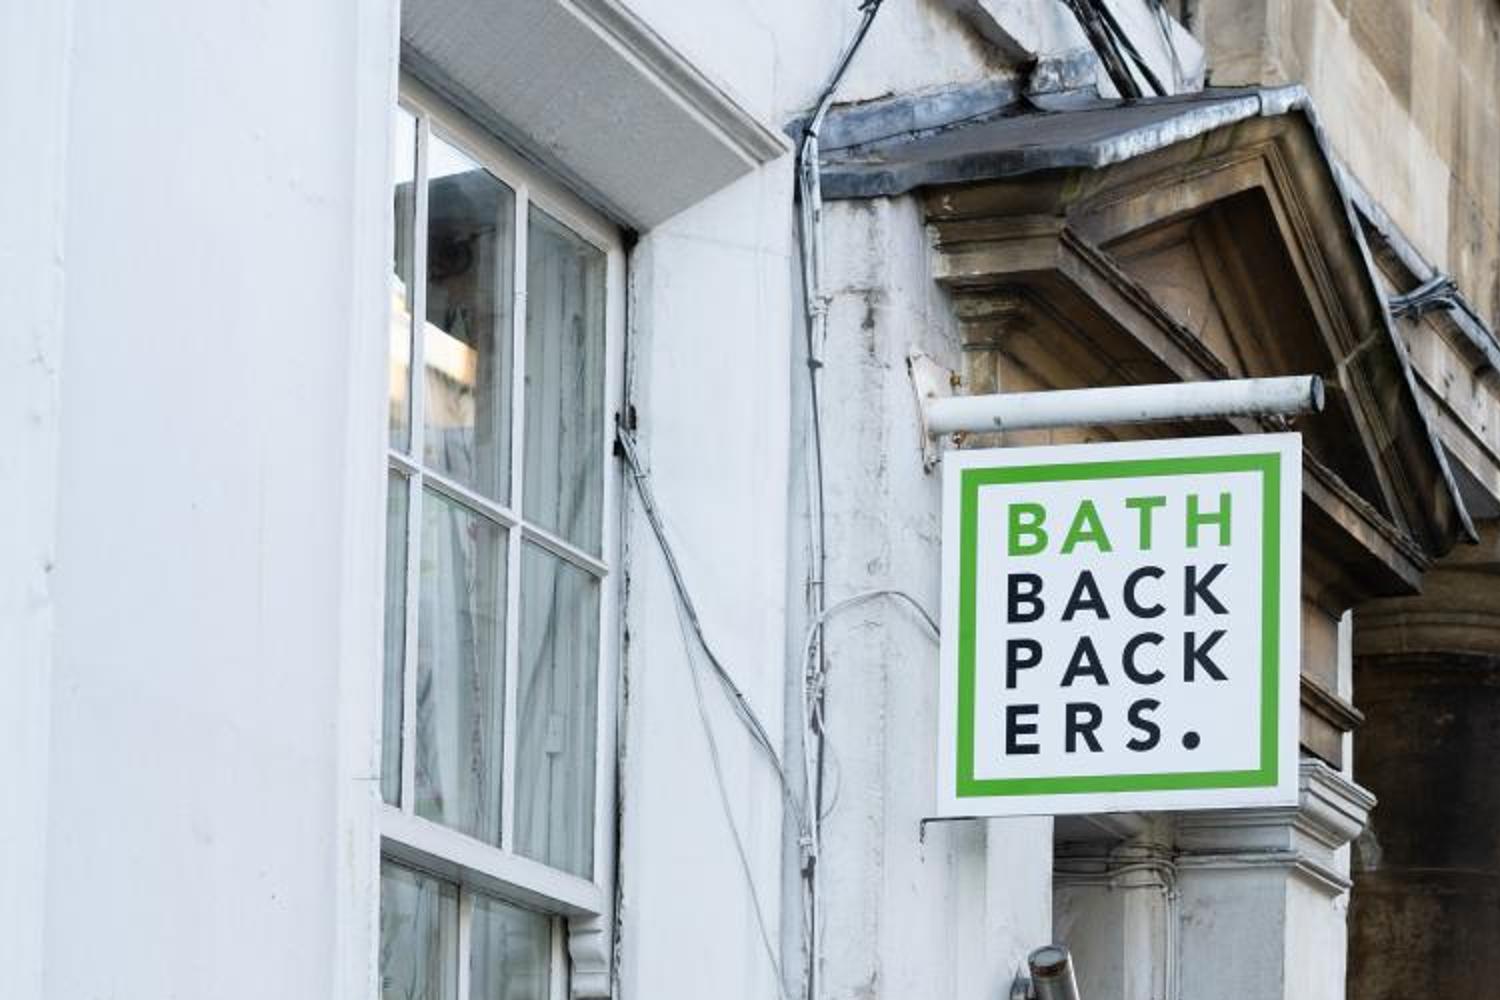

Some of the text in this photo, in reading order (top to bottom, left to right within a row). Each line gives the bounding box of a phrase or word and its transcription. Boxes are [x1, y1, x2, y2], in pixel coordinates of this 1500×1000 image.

[1007, 492, 1232, 556] BATH
[1006, 564, 1230, 624] BACK
[1005, 630, 1229, 689] PACK
[1005, 698, 1201, 756] ERS.
